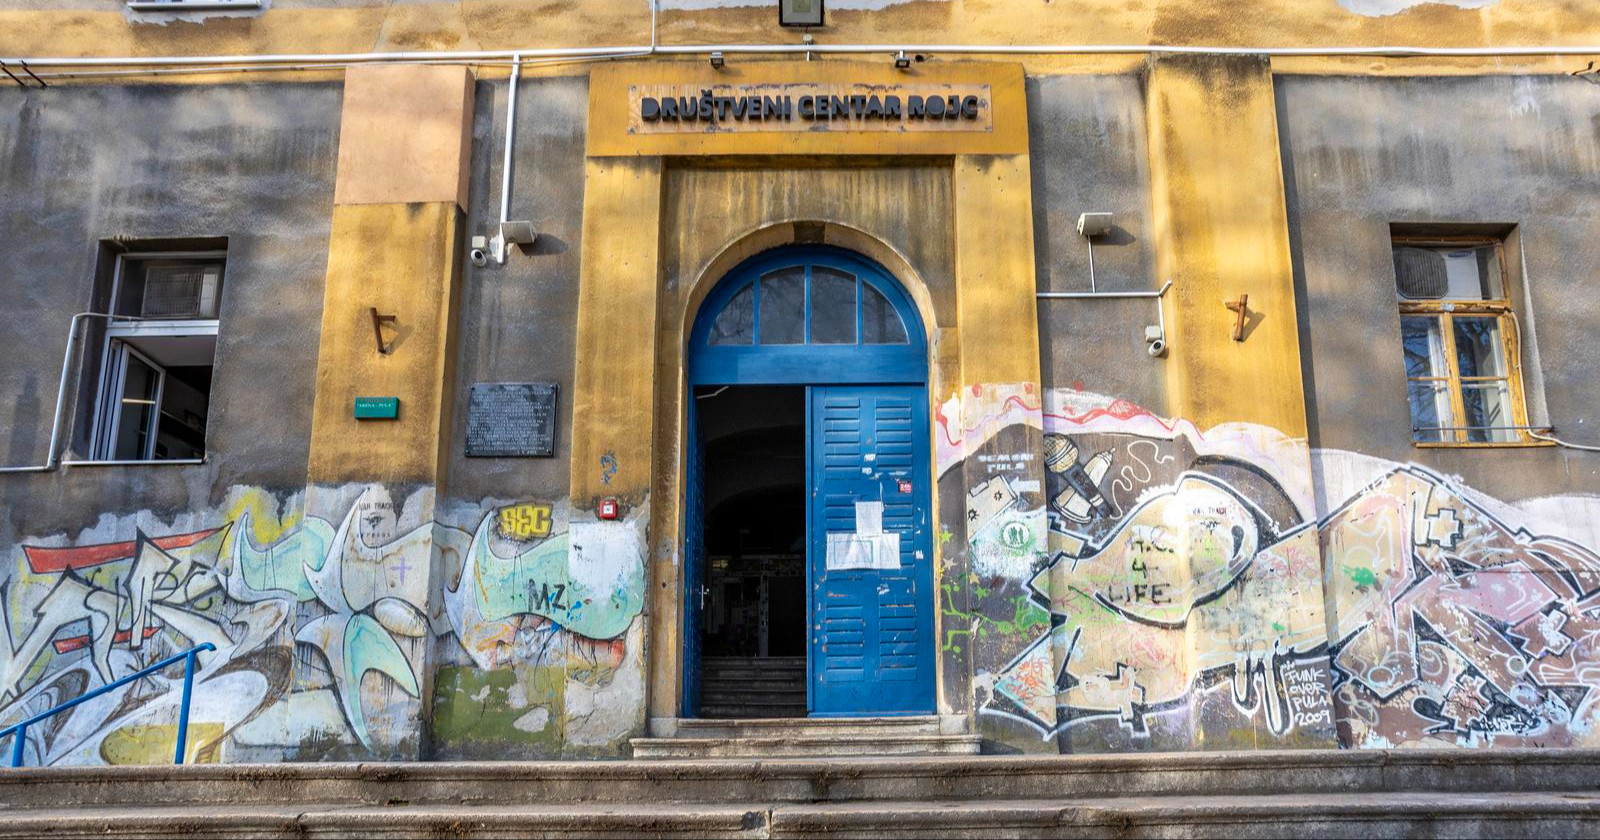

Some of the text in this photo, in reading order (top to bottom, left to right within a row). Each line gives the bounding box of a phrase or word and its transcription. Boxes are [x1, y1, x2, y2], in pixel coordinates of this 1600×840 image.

[642, 89, 979, 121] DRUŠTVENI CENTAR ROJC
[1108, 583, 1172, 605] LIFE
[1285, 667, 1326, 684] FUNK
[1292, 695, 1328, 712] PULA
[1294, 710, 1331, 726] 2009
